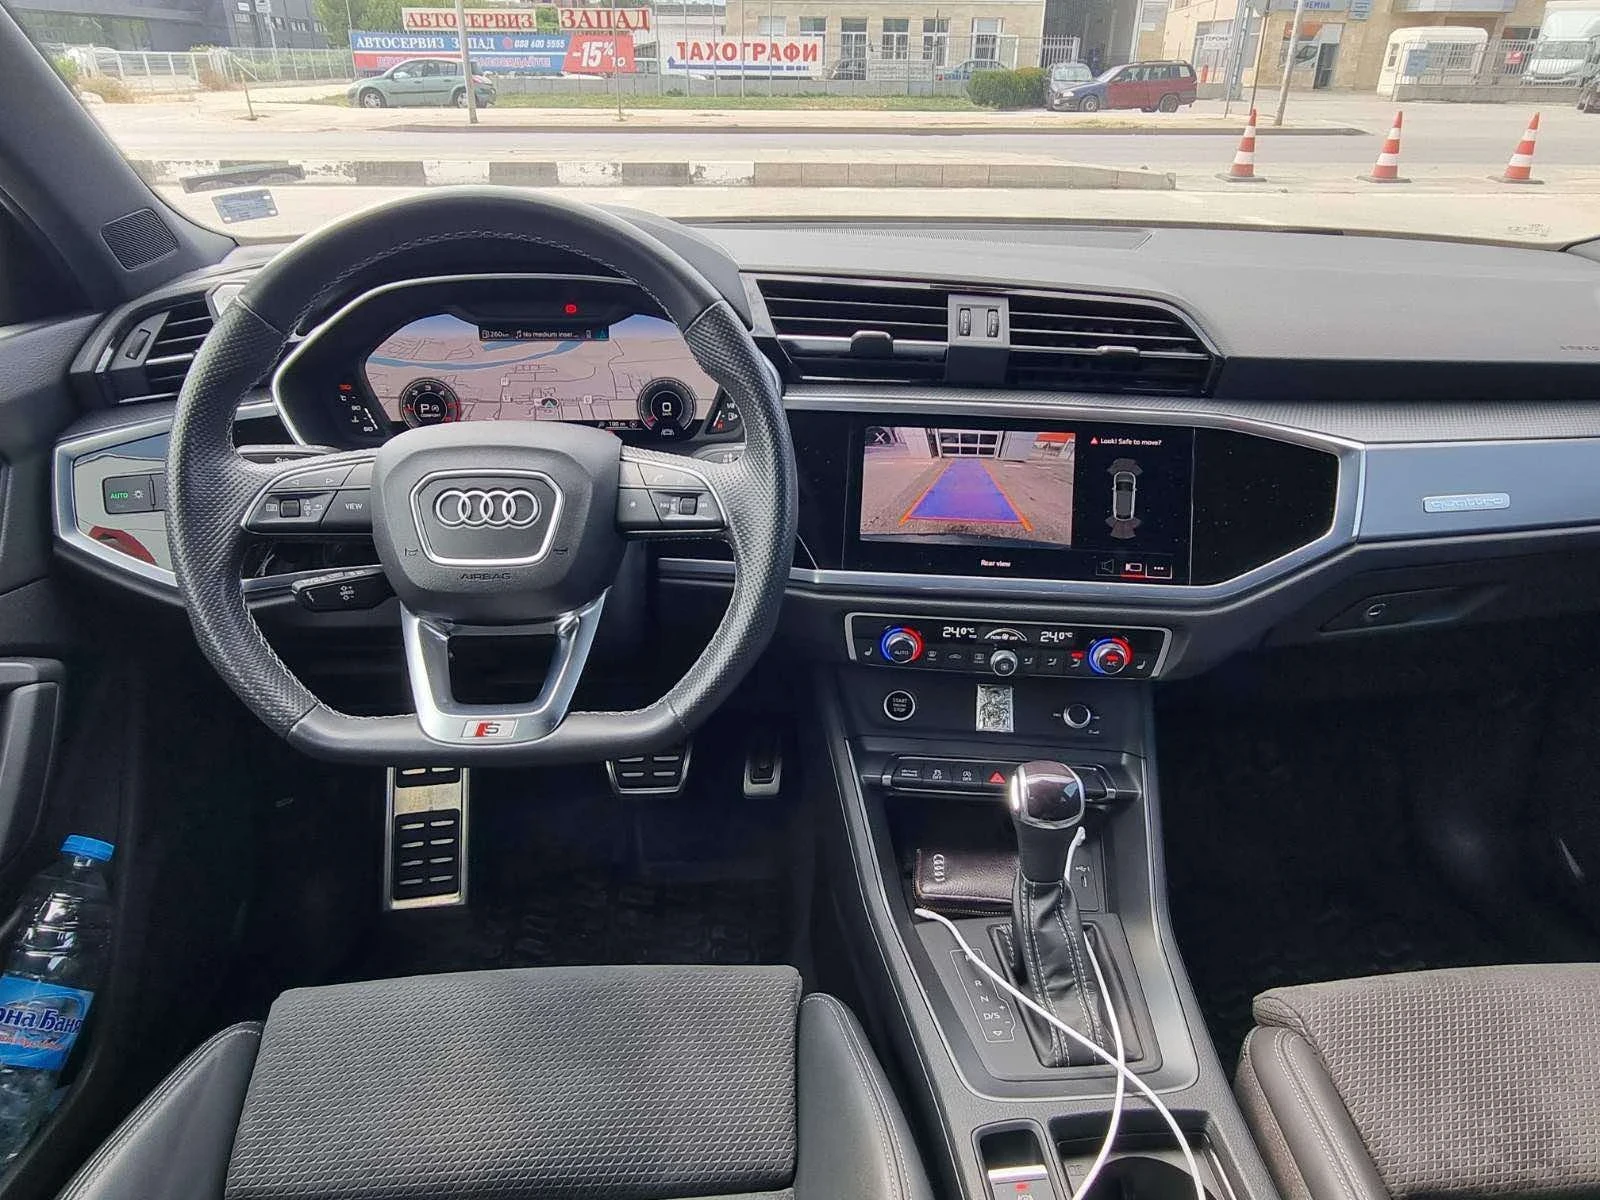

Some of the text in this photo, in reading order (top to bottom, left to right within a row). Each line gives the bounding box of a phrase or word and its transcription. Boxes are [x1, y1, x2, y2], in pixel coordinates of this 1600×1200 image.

[406, 12, 533, 29] АВТОЕРВИЗ
[561, 9, 650, 32] ЗАПАД
[356, 37, 445, 49] АВТОСЕРВИЗ
[451, 37, 495, 50] ЗПАД
[572, 41, 614, 67] -15%
[676, 41, 818, 62] ТАХОГРАФИ
[420, 403, 430, 413] P
[1100, 437, 1117, 445] Look!
[980, 559, 995, 567] Rear
[460, 572, 511, 580] AIRBAG
[980, 995, 989, 1003] N
[39, 1008, 81, 1033] Баня
[983, 1012, 1001, 1021] D/S
